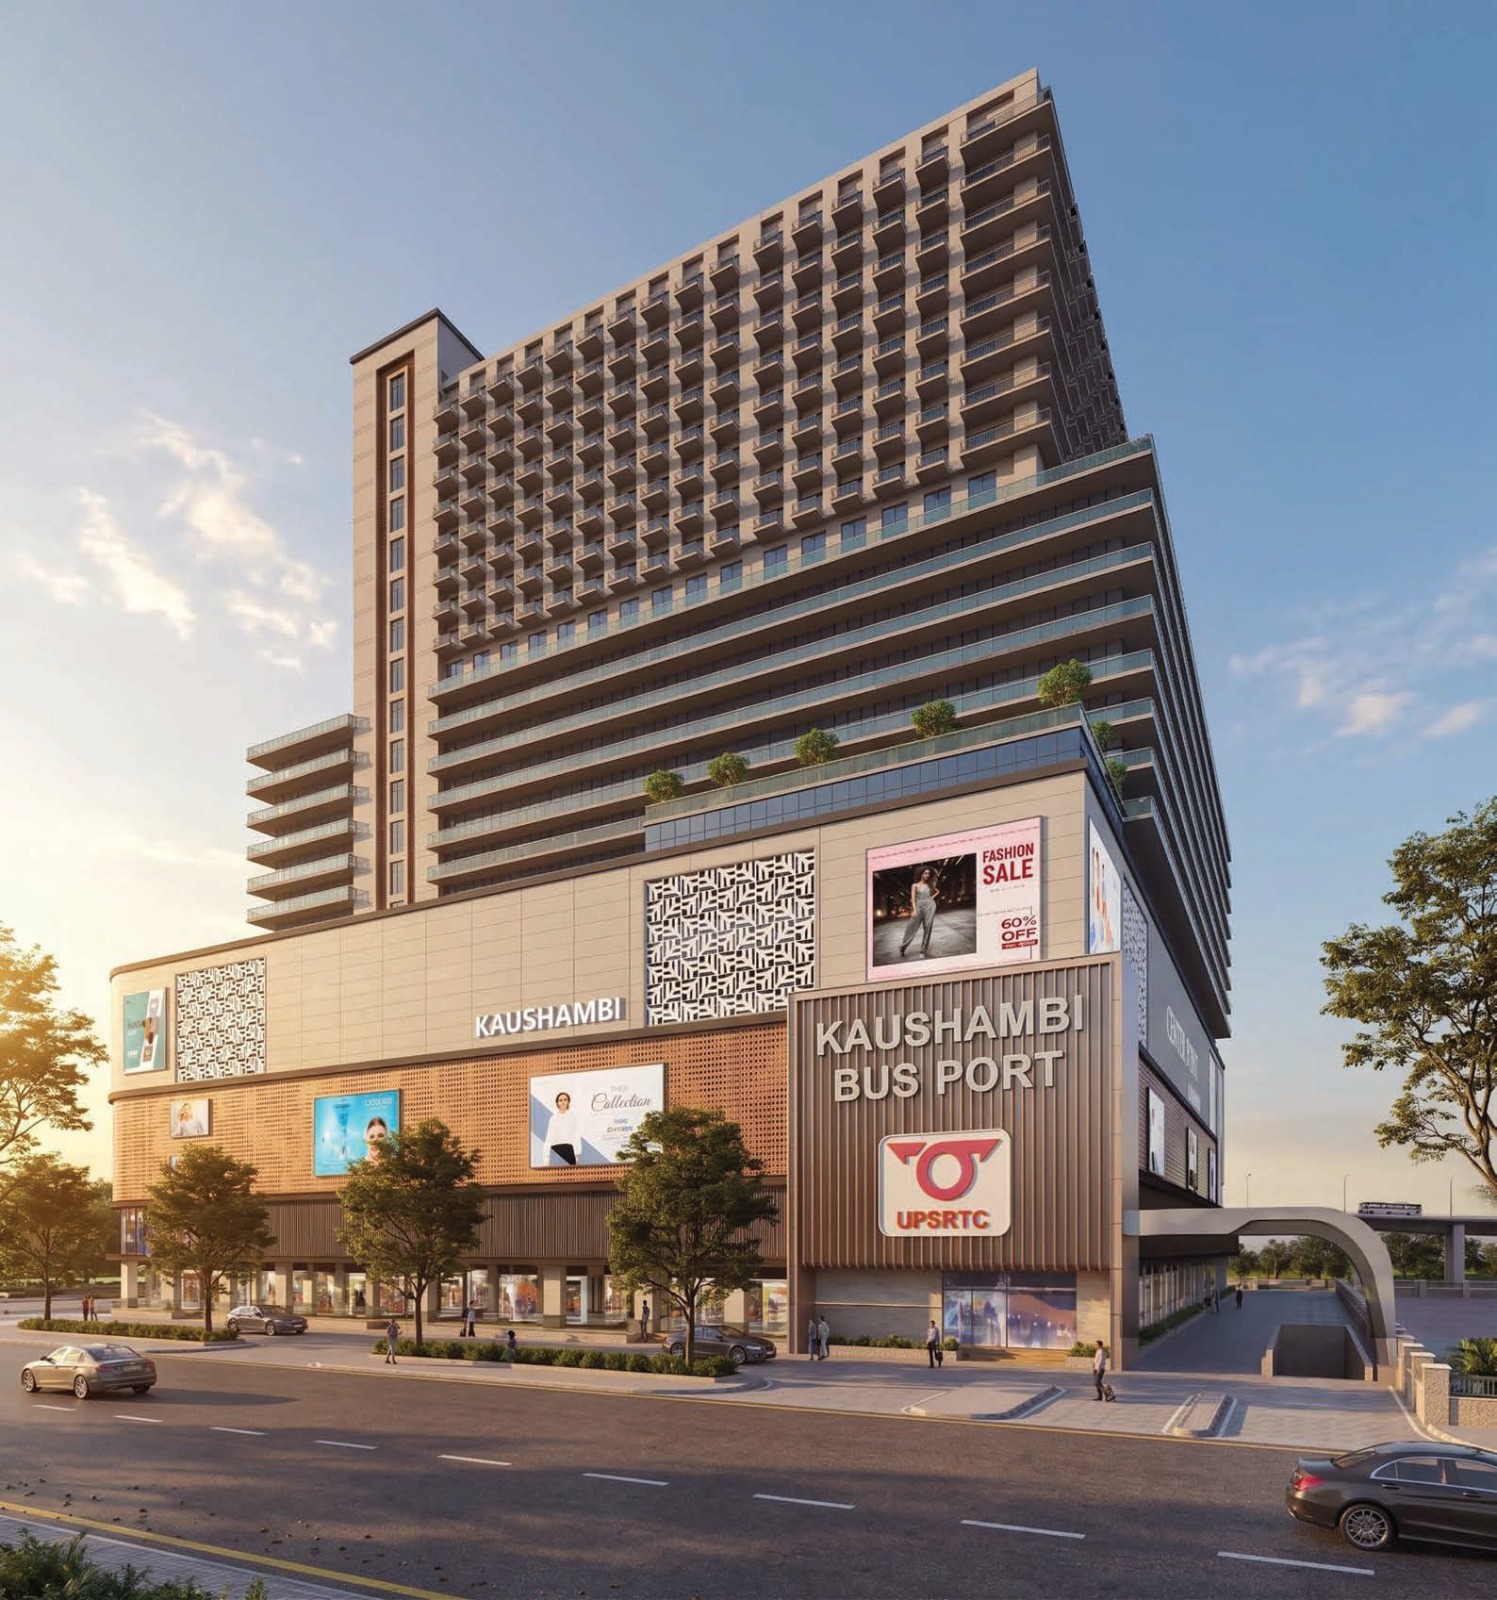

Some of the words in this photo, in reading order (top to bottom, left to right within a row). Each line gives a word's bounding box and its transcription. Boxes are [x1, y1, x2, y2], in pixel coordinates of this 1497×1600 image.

[982, 843, 1034, 863] FASHION
[983, 858, 1034, 885] SALE
[1001, 915, 1037, 930] 60%
[1001, 927, 1037, 942] OFF
[475, 997, 624, 1039] KAUSHAMBI
[816, 994, 1083, 1056] KAUSHAMBI
[834, 1062, 920, 1102] BUS
[937, 1050, 1064, 1095] PORT
[896, 1210, 991, 1230] UPSRTC
